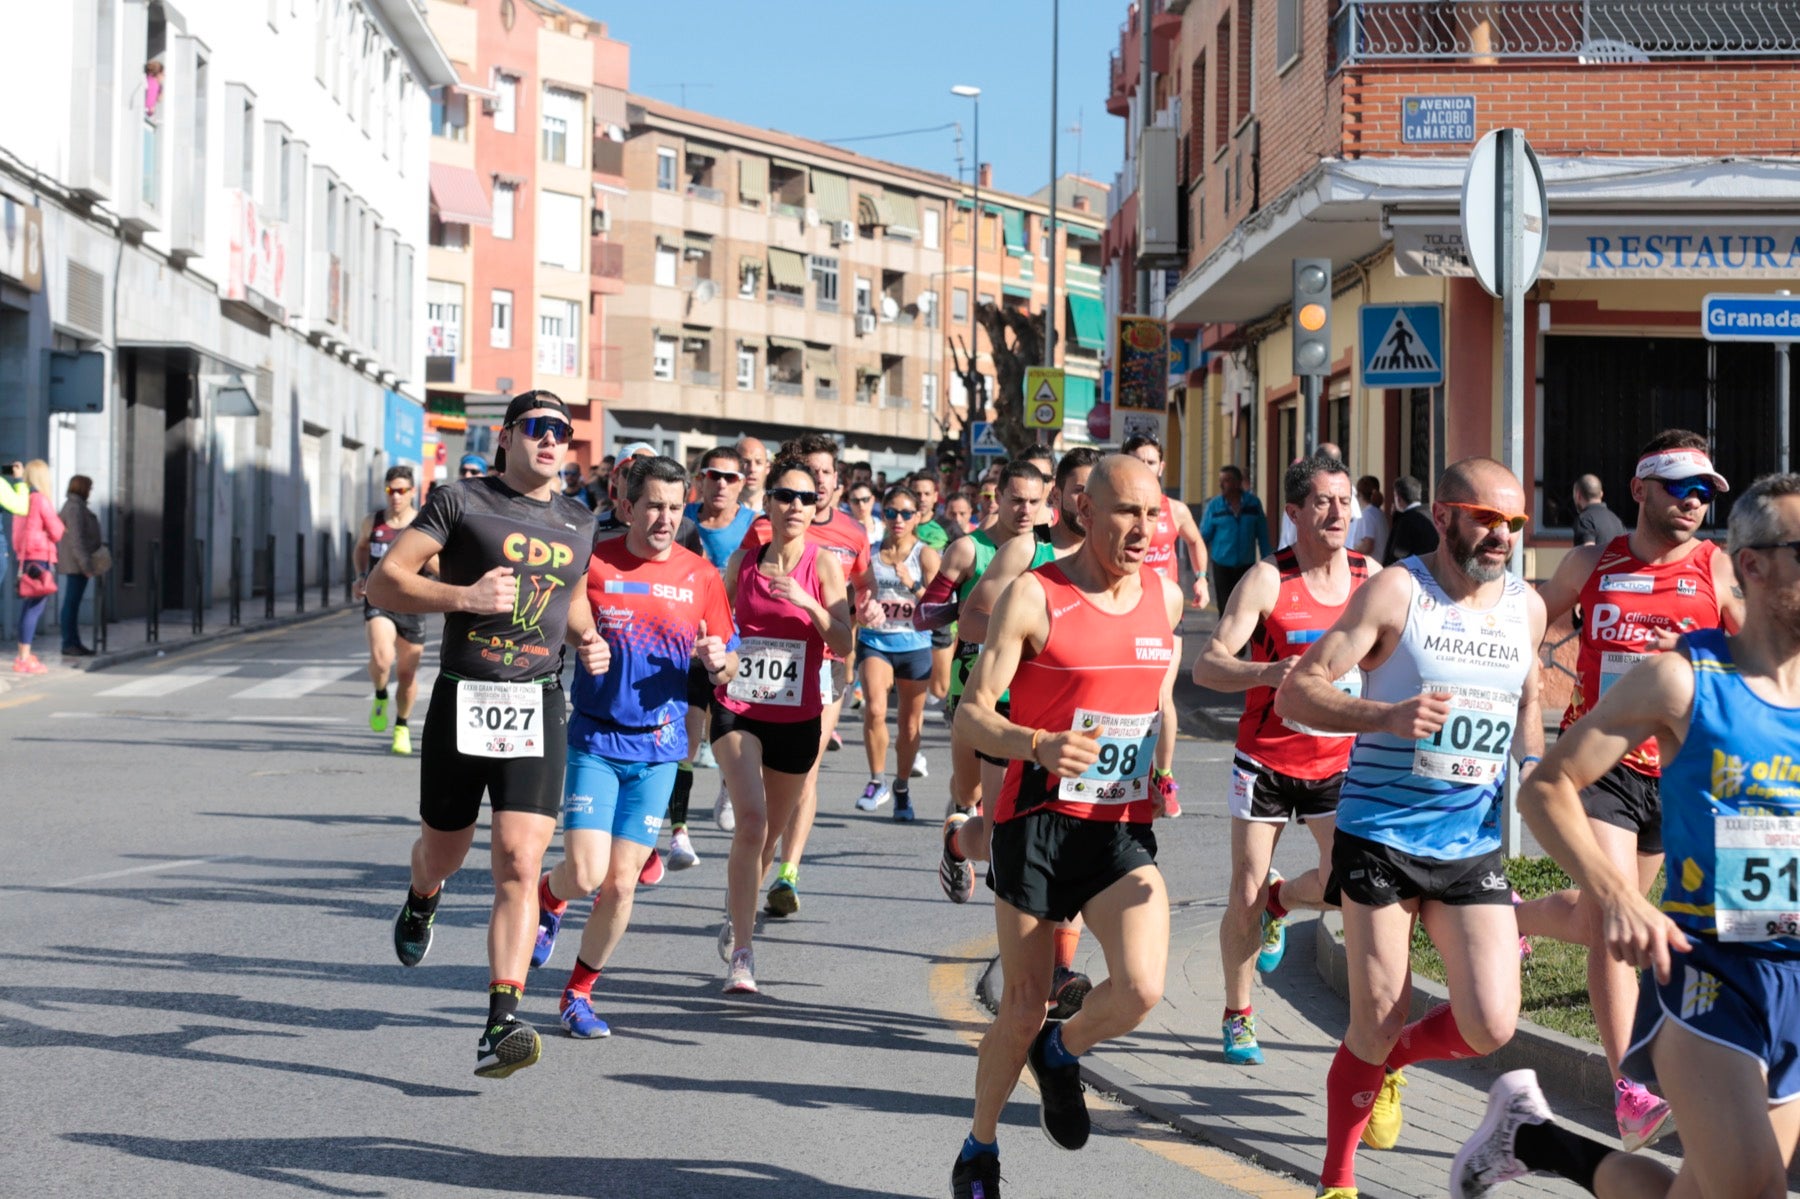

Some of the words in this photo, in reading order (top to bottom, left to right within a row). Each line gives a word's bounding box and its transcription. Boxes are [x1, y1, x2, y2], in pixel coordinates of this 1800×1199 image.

[1420, 99, 1472, 110] AVENIDA
[1423, 110, 1467, 125] JACOBO
[1407, 125, 1472, 140] CAMARERO
[1710, 307, 1800, 328] Granada
[503, 532, 574, 569] CDP
[652, 583, 694, 604] SEUR
[1423, 634, 1520, 662] MARACENA
[739, 657, 798, 682] 3104
[1436, 654, 1455, 663] CLUB
[1457, 656, 1466, 664] DE
[1470, 659, 1510, 669] ATLETISMO
[468, 706, 535, 731] 3027
[1096, 743, 1139, 776] 98
[1741, 857, 1798, 903] 51
